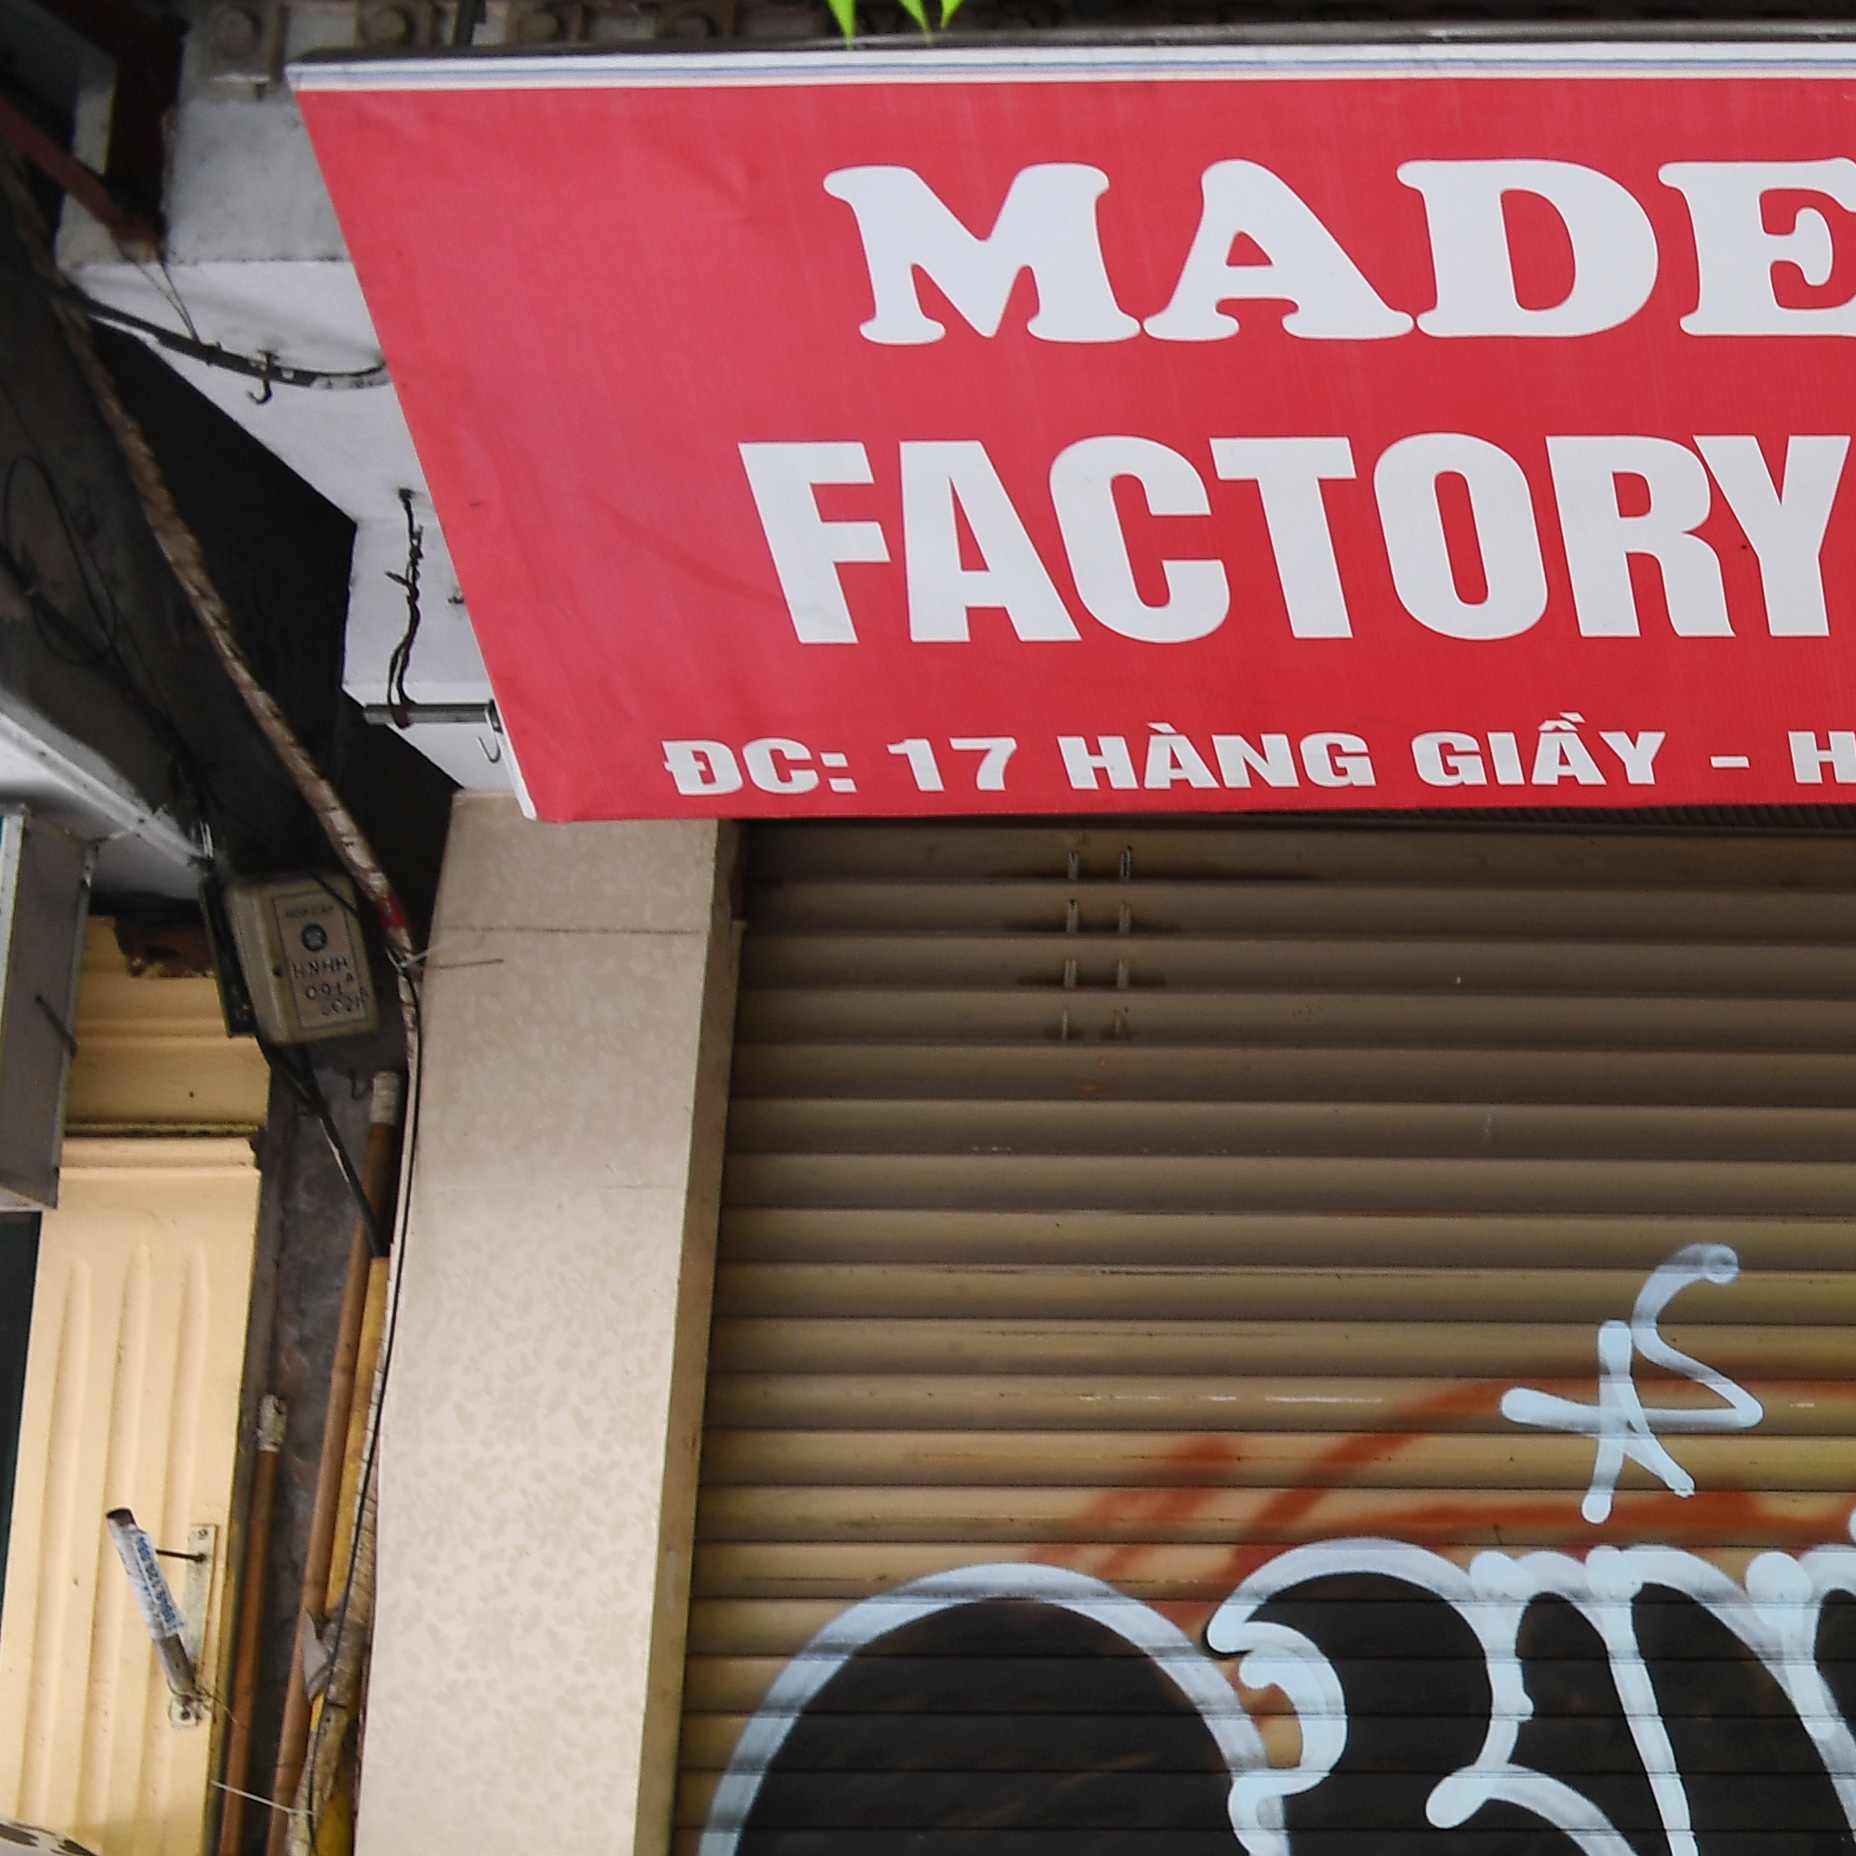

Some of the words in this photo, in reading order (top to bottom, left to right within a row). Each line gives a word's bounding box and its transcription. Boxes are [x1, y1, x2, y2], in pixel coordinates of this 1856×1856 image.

[738, 433, 1851, 644] FACTORY
[662, 738, 856, 795] ĐC:
[888, 737, 1017, 791] 17
[1058, 723, 1376, 789] HÀNG
[1412, 713, 1665, 786] GIẦY
